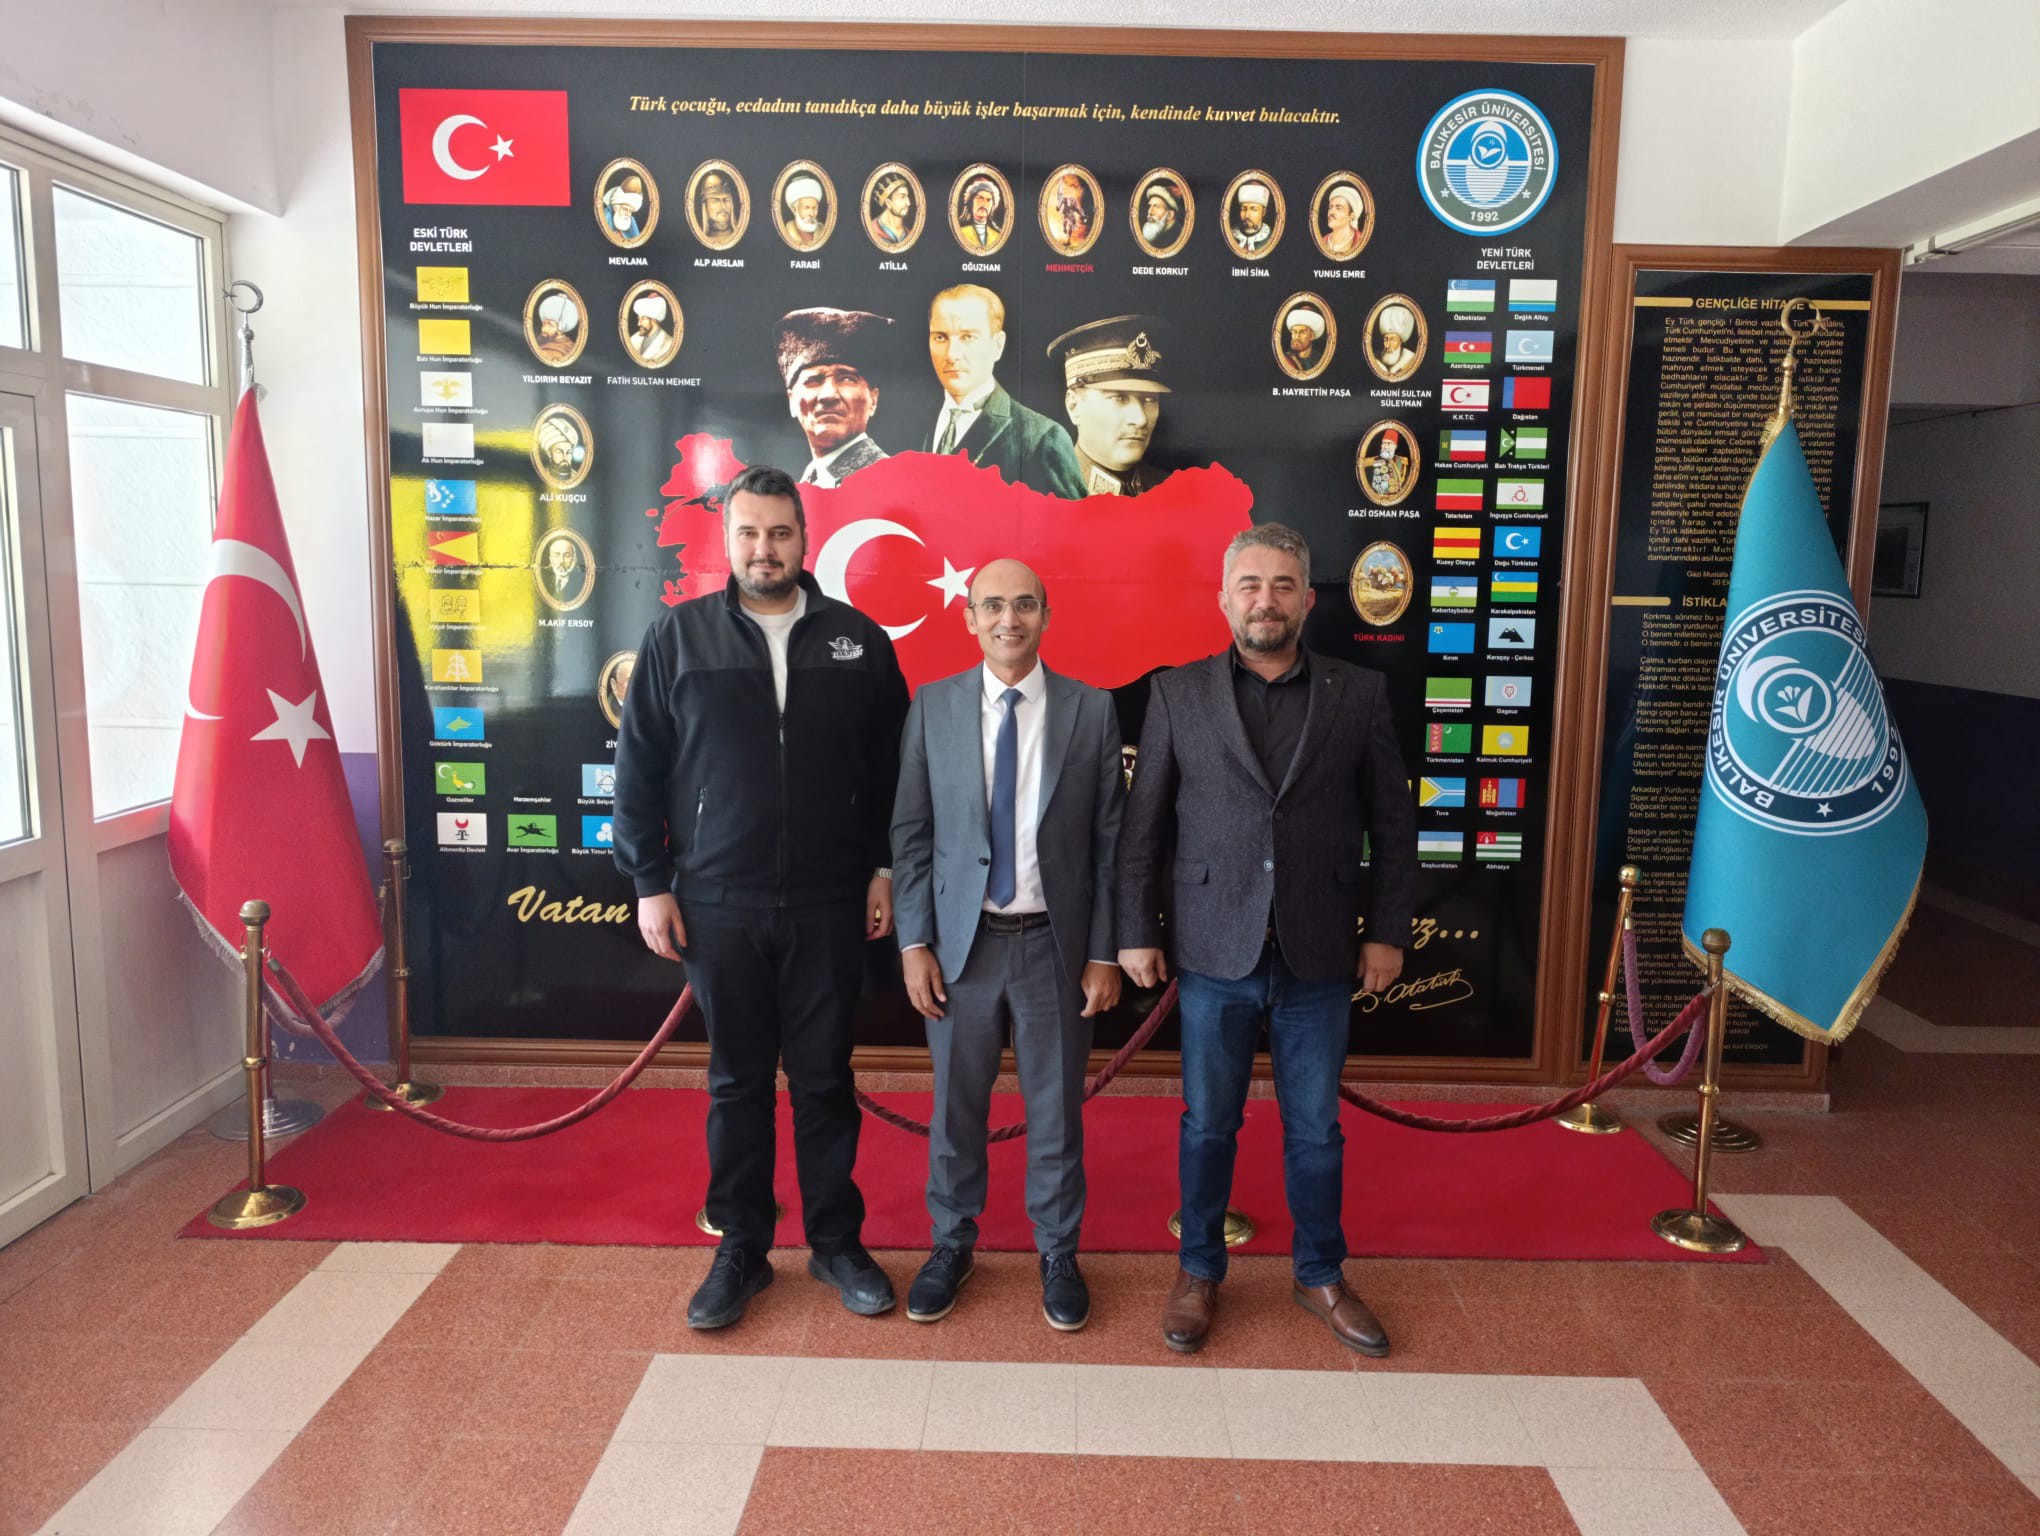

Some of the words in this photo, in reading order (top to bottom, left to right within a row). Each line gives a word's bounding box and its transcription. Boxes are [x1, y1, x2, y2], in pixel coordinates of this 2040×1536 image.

[630, 95, 667, 112] Türk
[671, 97, 731, 115] çocuğu,
[736, 98, 801, 114] ecdadını
[805, 99, 876, 117] tanıdıkça
[881, 100, 919, 116] daha
[924, 100, 972, 119] büyük
[975, 101, 1009, 120] işler
[1012, 102, 1087, 120] başarmak
[1092, 102, 1126, 121] için,
[1130, 104, 1201, 121] kendinde
[1204, 106, 1256, 122] kuvvet
[1258, 106, 1340, 124] bulacaktır.
[1431, 106, 1478, 168] BALIKESİR
[1482, 102, 1546, 171] ÜNİVERSİTESİ
[1469, 210, 1500, 223] 1992
[414, 226, 437, 238] ESKİ
[439, 227, 468, 238] TÜRK
[410, 240, 472, 252] DEVLETLERİ
[1481, 246, 1503, 257] YENİ
[1506, 247, 1531, 258] TÜRK
[608, 256, 648, 266] MEVLANA
[694, 258, 710, 267] ALP
[712, 259, 744, 268] ARSLAN
[790, 259, 820, 269] FARABİ
[878, 261, 908, 271] ATİLLA
[1476, 260, 1534, 270] DEVLETLERİ
[962, 262, 1001, 272] OĞUZHAN
[1046, 262, 1094, 274] MEHMETÇİK
[1132, 266, 1154, 275] DEDE
[1156, 266, 1189, 276] KORKUT
[1232, 266, 1248, 277] İBNİ
[1250, 267, 1270, 278] SİNA
[1313, 269, 1340, 278] YUNUS
[1342, 269, 1366, 278] EMRE
[1696, 296, 1758, 310] GENÇLİĞE
[1534, 314, 1548, 322] Altay
[522, 374, 558, 384] YILDIRIM
[559, 375, 592, 384] BEYAZIT
[607, 376, 630, 386] FATİH
[632, 376, 664, 386] SULTAN
[666, 377, 701, 386] MEHMET
[1272, 388, 1280, 396] B.
[1282, 387, 1328, 397] HAYRETTİN
[1330, 388, 1351, 398] PAŞA
[1370, 388, 1400, 398] KANUNİ
[1402, 390, 1432, 398] SULTAN
[1380, 398, 1422, 408] SÜLEYMAN
[540, 492, 553, 502] ALİ
[555, 494, 586, 504] KUŞÇU
[1348, 509, 1367, 518] GAZİ
[1368, 510, 1398, 518] OSMAN
[1399, 510, 1420, 520] PAŞA
[538, 617, 566, 627] M.AKİF
[568, 619, 594, 628] ERSOY
[1354, 632, 1376, 642] TÜRK
[1377, 634, 1404, 642] KADINI
[1711, 688, 1775, 809] BALIKESİR
[508, 886, 630, 924] Vatan
